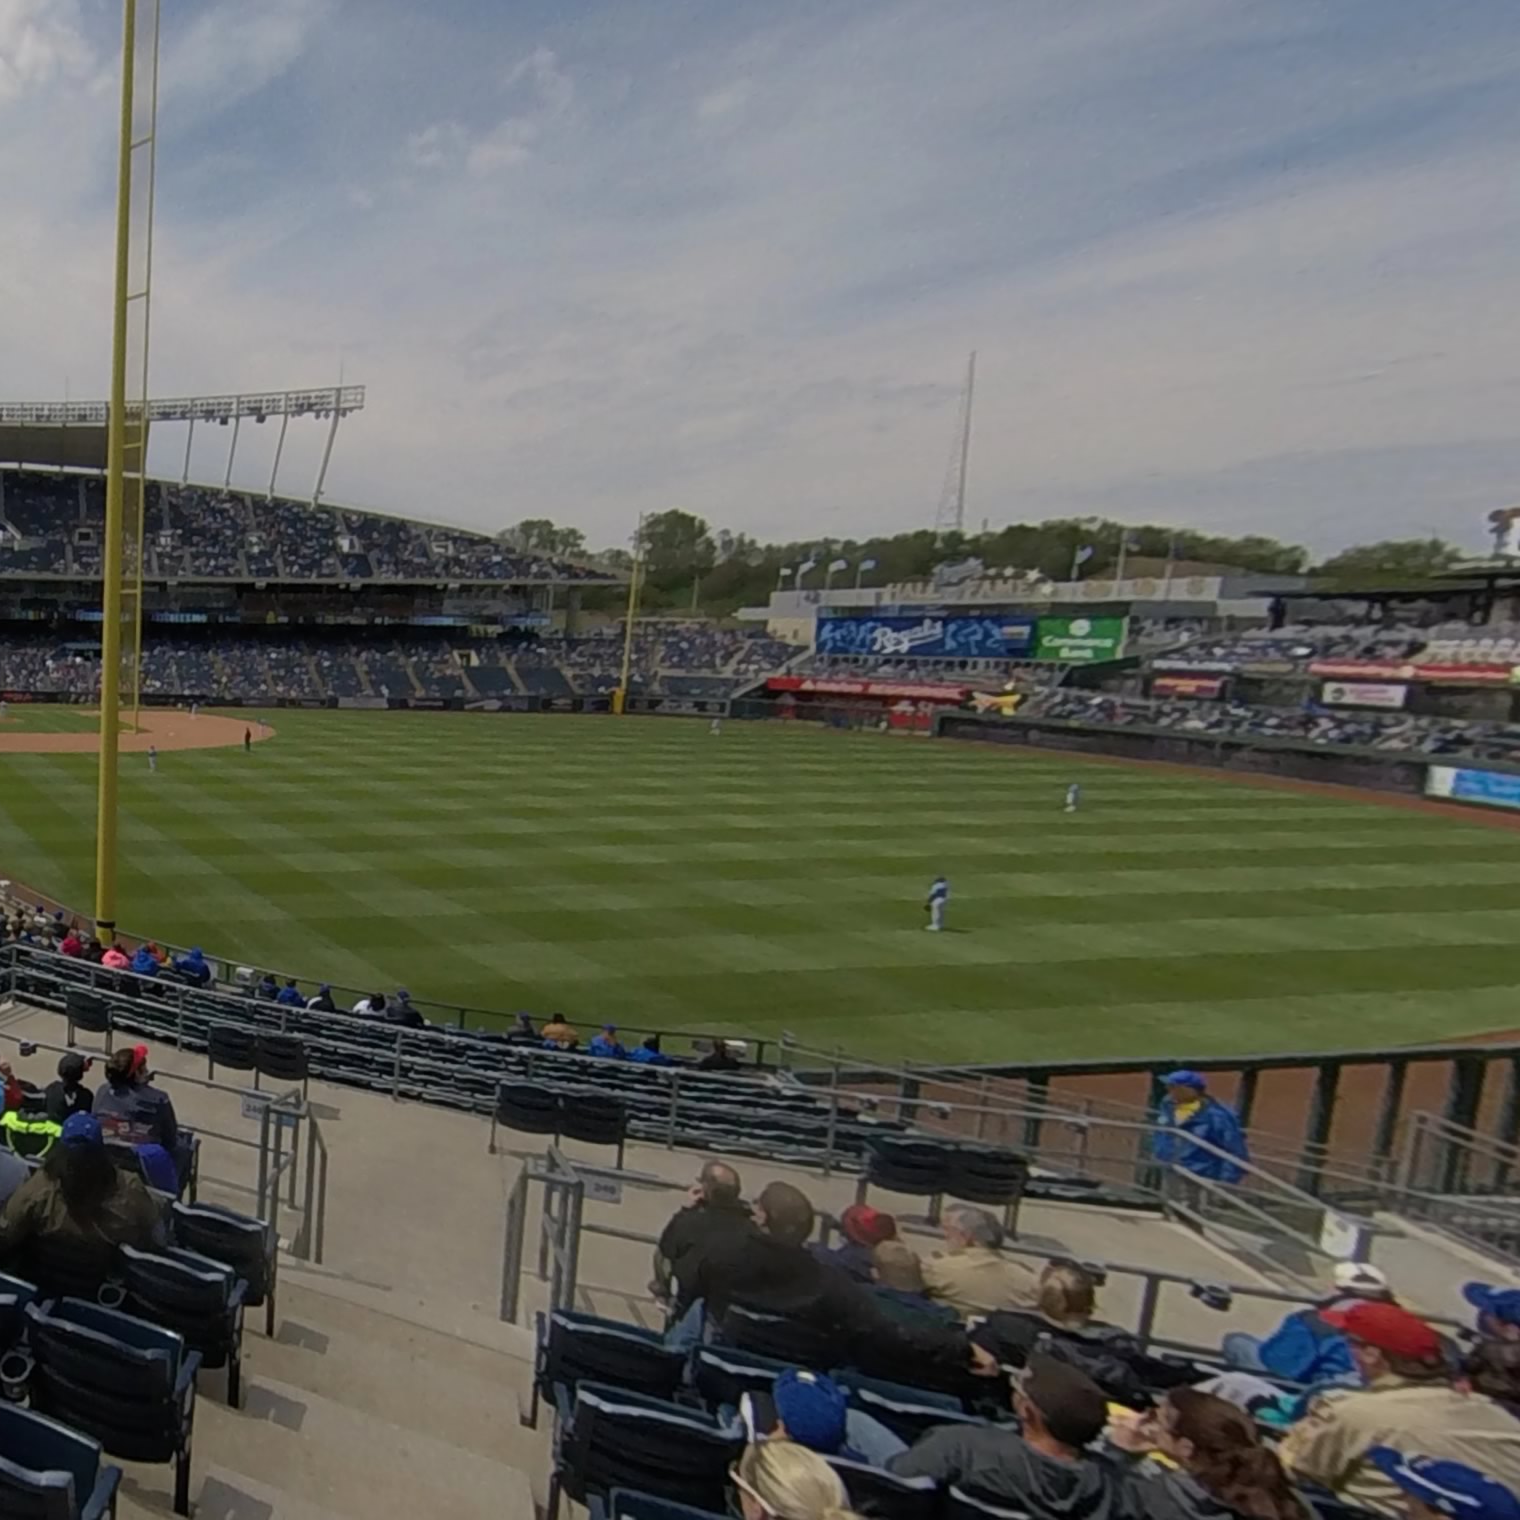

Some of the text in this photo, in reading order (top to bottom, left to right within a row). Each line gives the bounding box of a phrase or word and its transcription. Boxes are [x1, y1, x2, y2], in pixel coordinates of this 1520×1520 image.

[882, 582, 941, 601] HALL
[959, 578, 1033, 600] FAME
[872, 618, 943, 654] Royals
